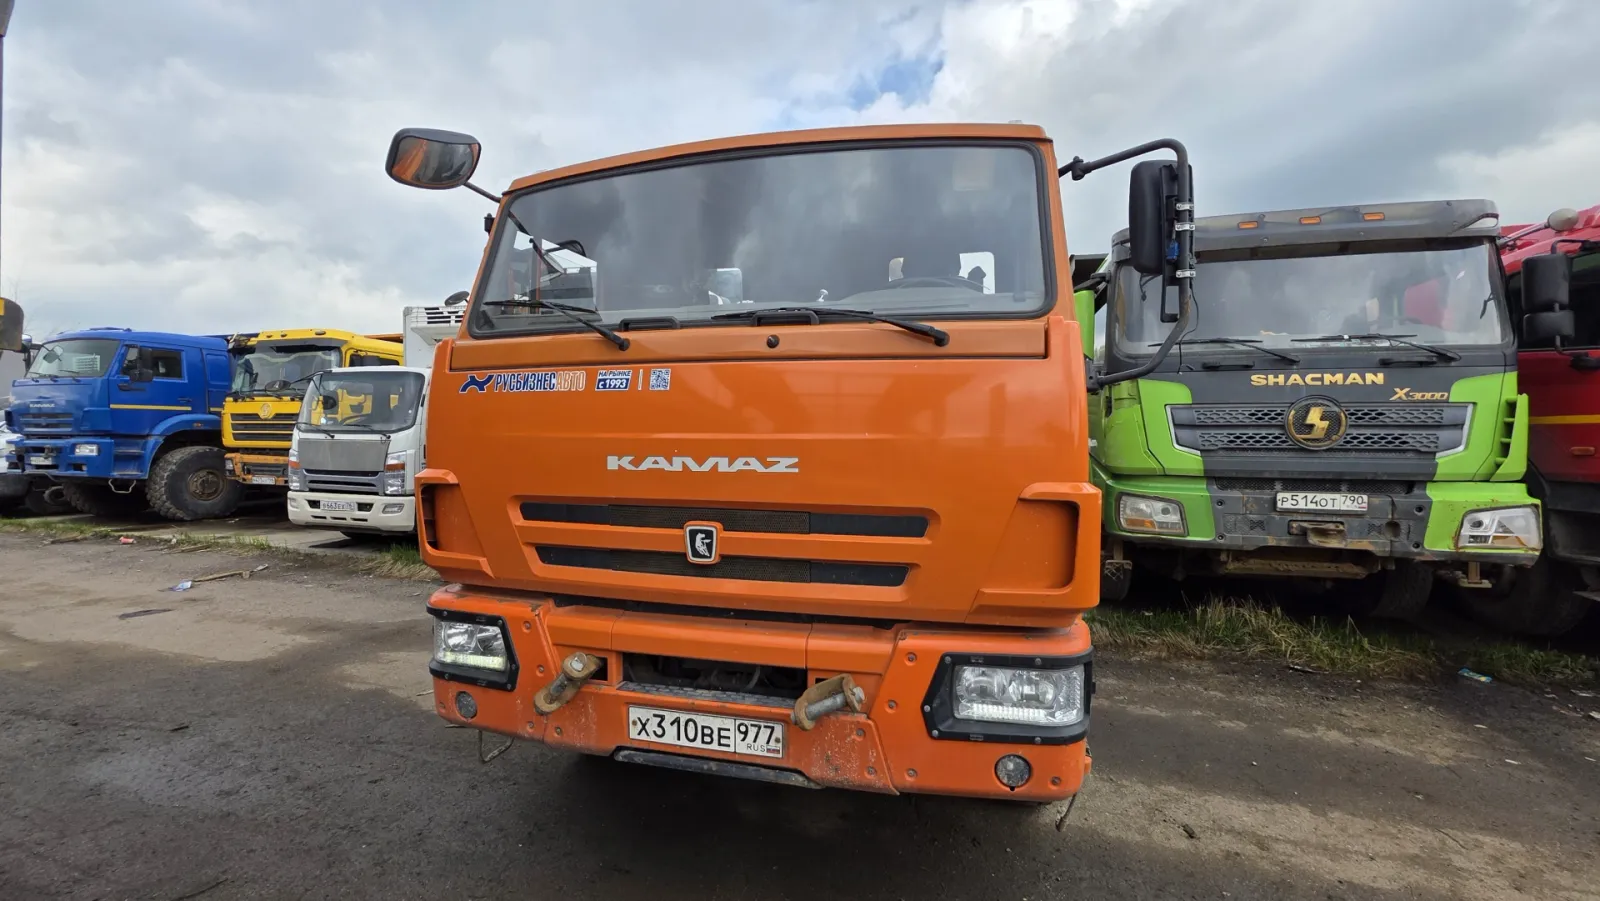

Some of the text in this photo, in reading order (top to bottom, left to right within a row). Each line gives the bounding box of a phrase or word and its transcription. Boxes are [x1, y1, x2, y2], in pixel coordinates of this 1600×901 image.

[495, 371, 586, 392] РУСБИЗНЕСАВТО
[1250, 373, 1385, 386] SHACMAN
[1389, 387, 1449, 401] X3000
[606, 455, 799, 473] KAMAZ
[1341, 495, 1364, 505] 790
[636, 713, 775, 748] Х310ВЕ 977
[746, 743, 766, 753] RUS
